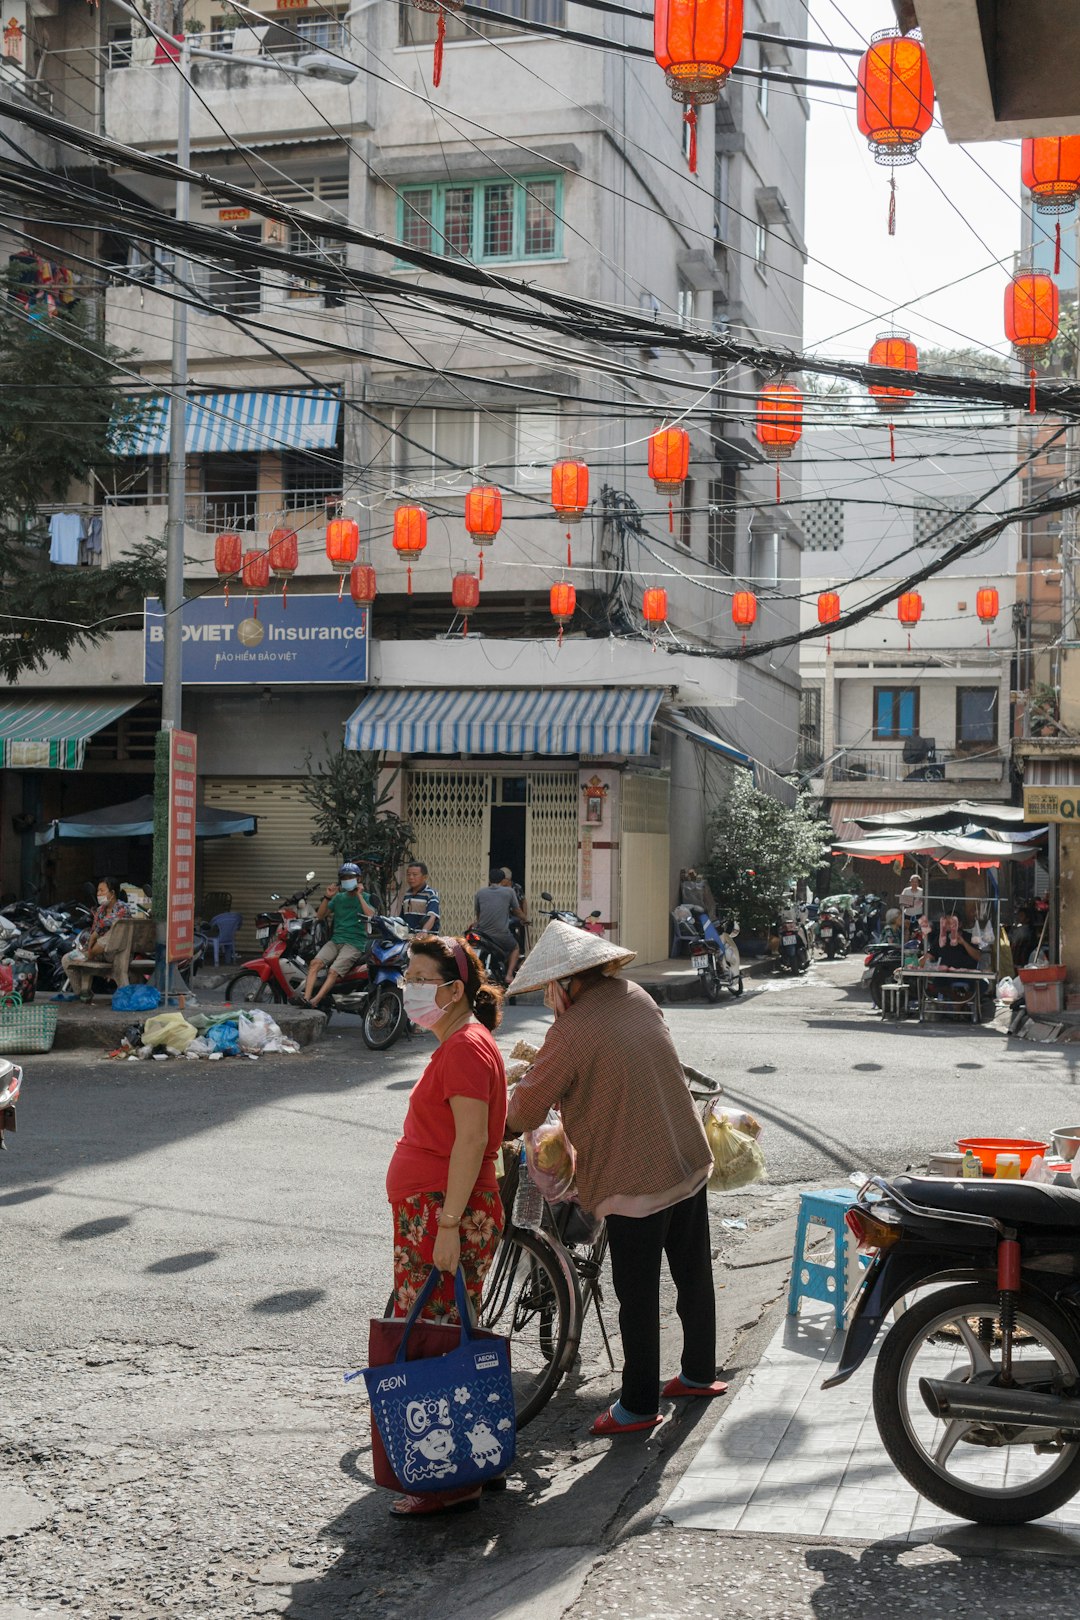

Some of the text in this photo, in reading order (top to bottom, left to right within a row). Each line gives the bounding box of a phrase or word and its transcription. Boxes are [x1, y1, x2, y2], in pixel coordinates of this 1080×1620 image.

[150, 624, 365, 642] BOVIET Insurance
[278, 652, 298, 662] VIỆT
[477, 1353, 496, 1363] AEON
